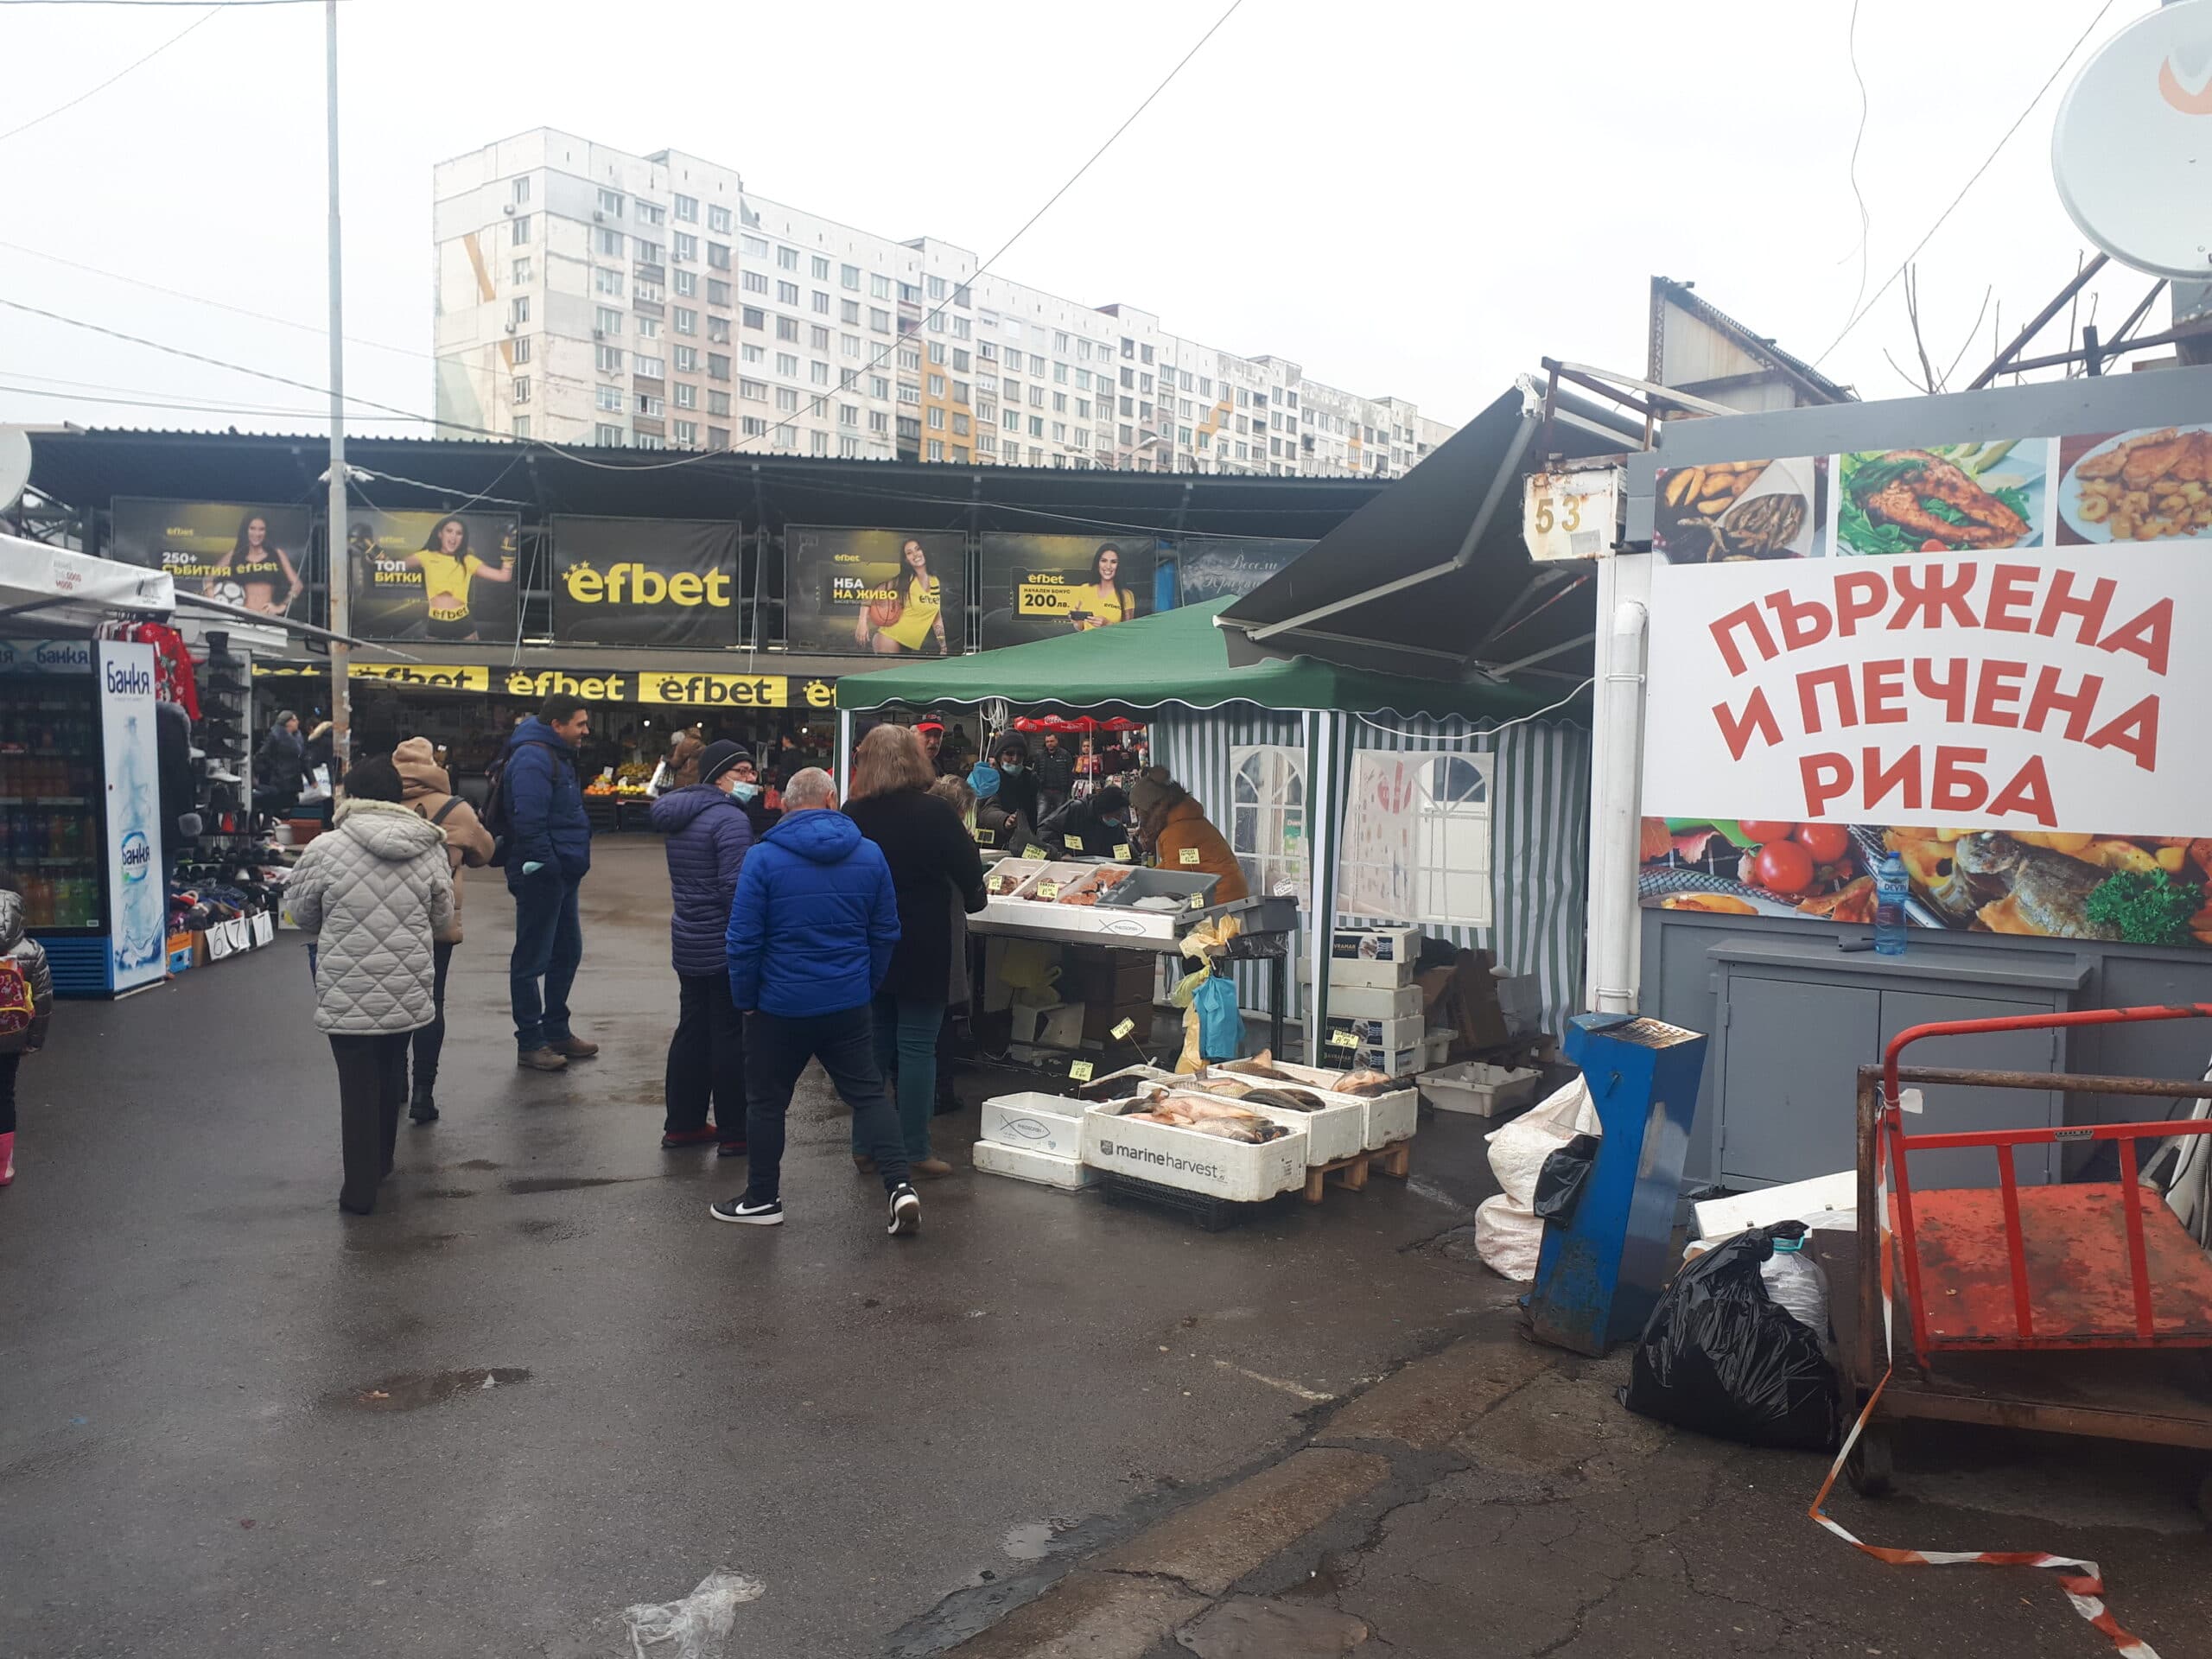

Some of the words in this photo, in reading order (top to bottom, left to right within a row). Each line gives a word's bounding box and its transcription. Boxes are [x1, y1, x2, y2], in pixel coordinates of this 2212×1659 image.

[1535, 495, 1580, 533] 53
[162, 551, 198, 563] 250+
[834, 554, 861, 563] efbet
[236, 562, 279, 575] efbet
[374, 560, 406, 572] ТОП
[374, 572, 422, 583] БИТКИ
[566, 562, 731, 607] efbet
[834, 577, 864, 589] НБА
[1027, 573, 1065, 585] efbet
[833, 589, 854, 600] НА
[855, 590, 899, 601] ЖИВО
[1708, 563, 2174, 677] ПЪРЖЕНА
[36, 646, 88, 664] банкя
[106, 661, 150, 695] банкя
[506, 671, 625, 701] efbet
[660, 676, 772, 705] efbet
[1712, 685, 1784, 762] И
[1796, 658, 2161, 772] ПЕЧЕНА
[1799, 745, 2058, 828] РИБА
[1885, 883, 1907, 893] DEVIN
